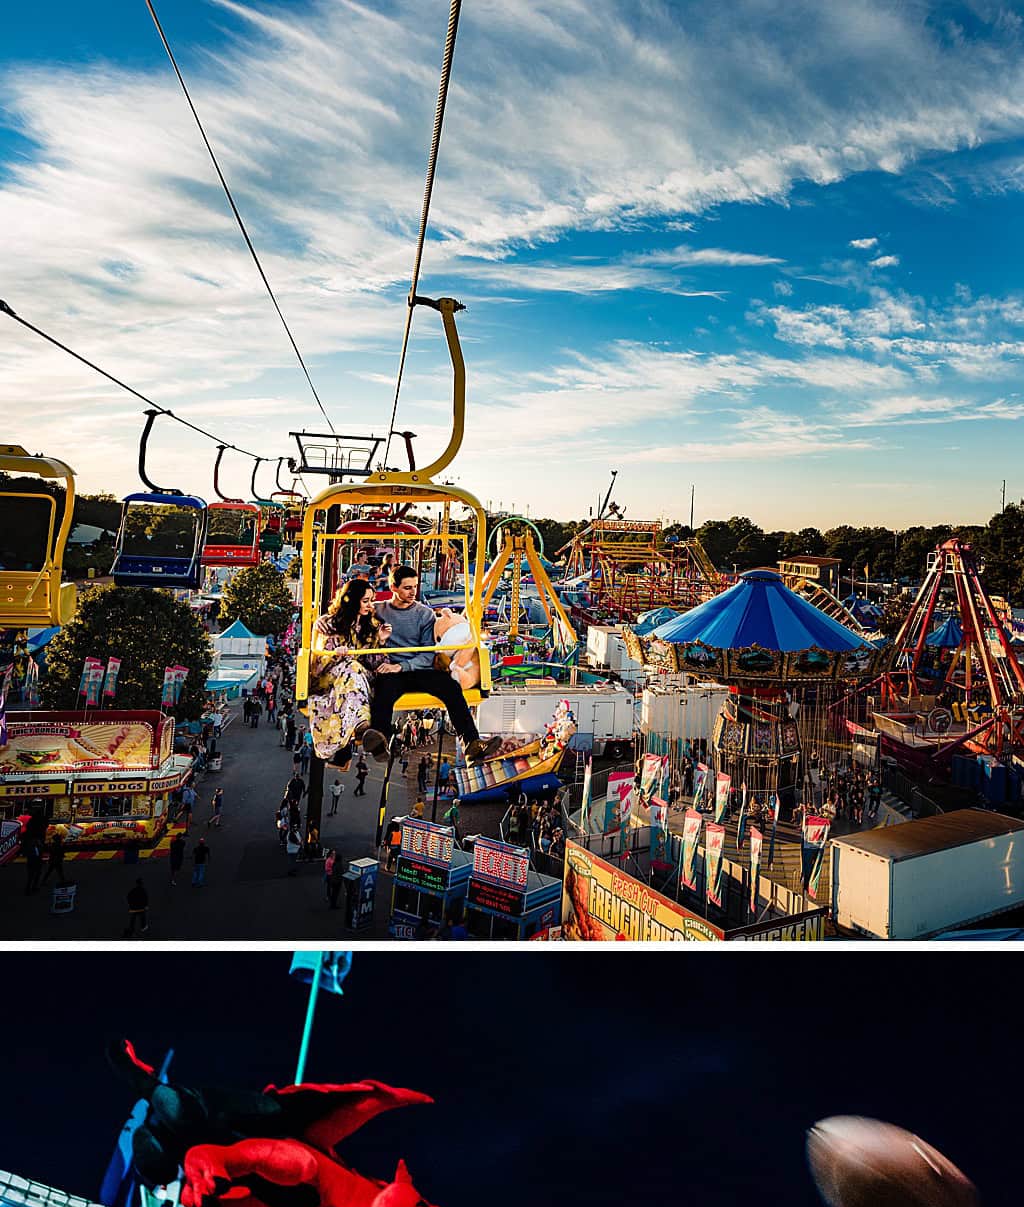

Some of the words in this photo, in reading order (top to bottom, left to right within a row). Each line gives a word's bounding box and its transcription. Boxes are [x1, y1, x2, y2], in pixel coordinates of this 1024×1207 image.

[6, 785, 49, 794] FRIES
[77, 783, 104, 792] HOT
[108, 782, 143, 791] DOGS
[474, 846, 527, 886] TICKETS
[361, 874, 374, 914] ATM
[589, 877, 640, 941] FRENCH
[612, 872, 640, 901] FRESH
[640, 889, 660, 916] CUT
